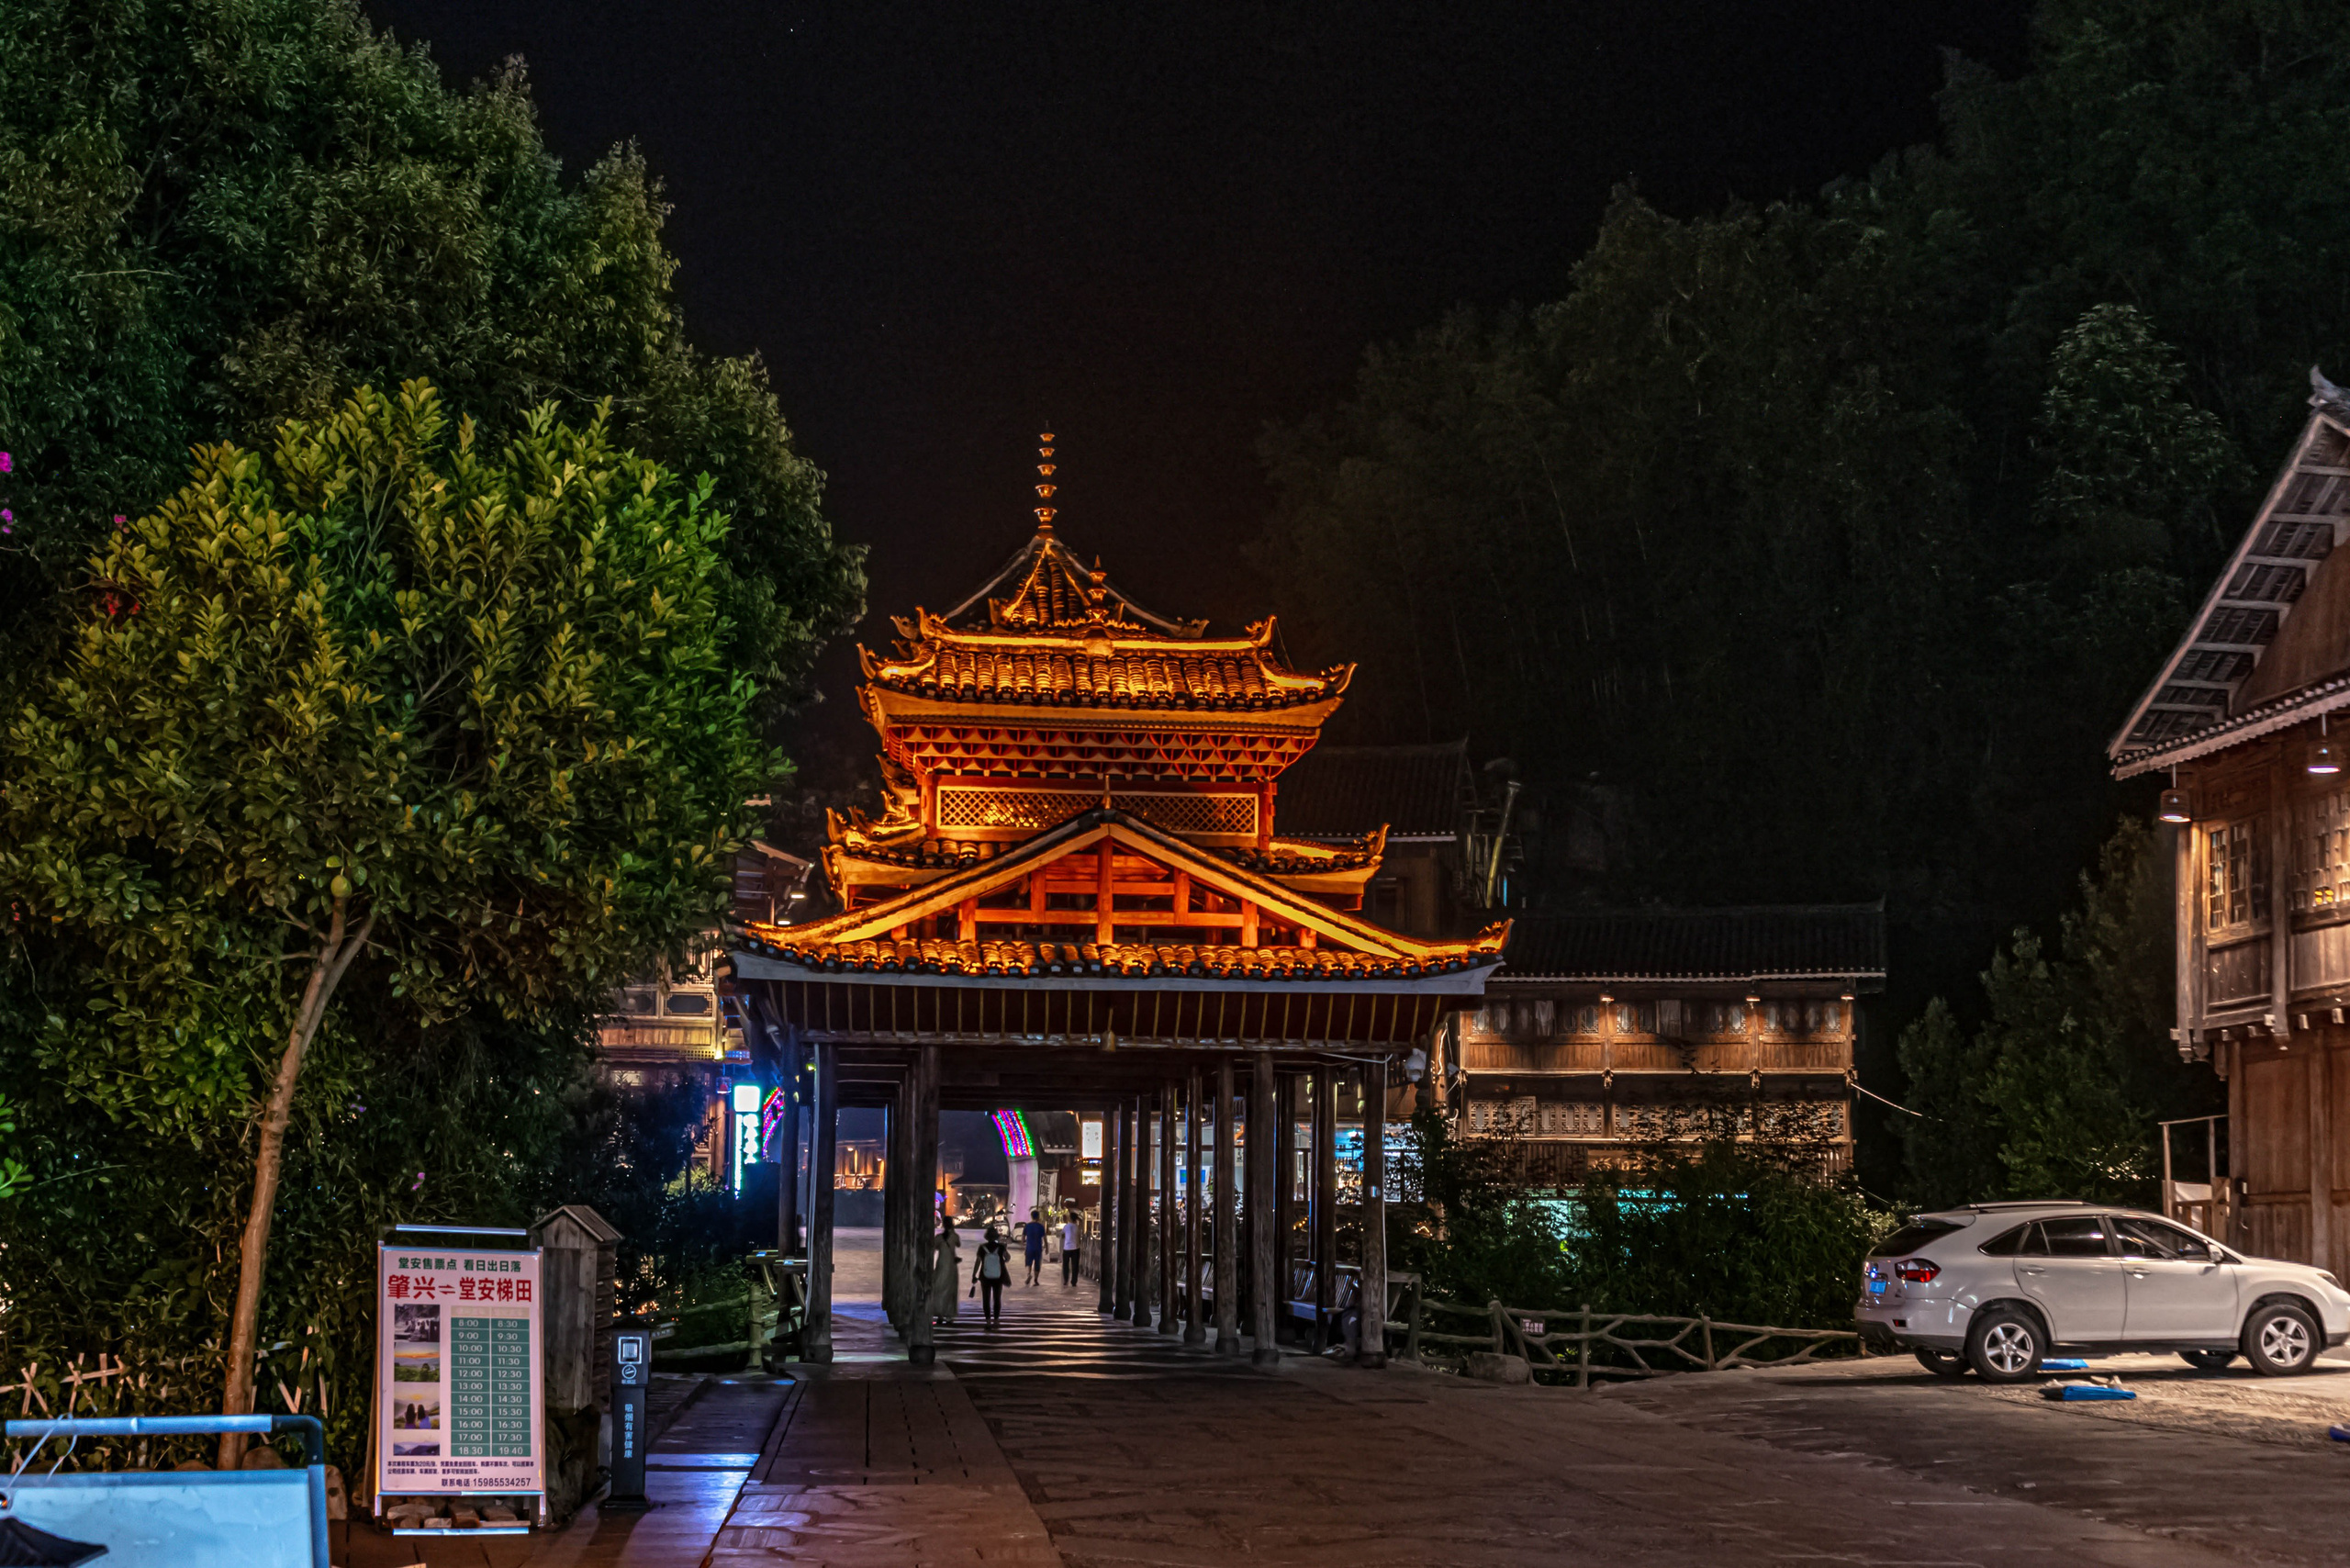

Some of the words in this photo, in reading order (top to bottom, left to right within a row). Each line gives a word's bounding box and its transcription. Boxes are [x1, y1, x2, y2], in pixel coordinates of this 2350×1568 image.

[398, 1257, 457, 1271] 堂安售票点
[464, 1259, 521, 1272] 看日出日落
[387, 1274, 435, 1299] 肇兴
[459, 1277, 532, 1302] 堂安梯田
[624, 1404, 633, 1458] 吸烟有害健康
[473, 1477, 532, 1486] 15985534257
